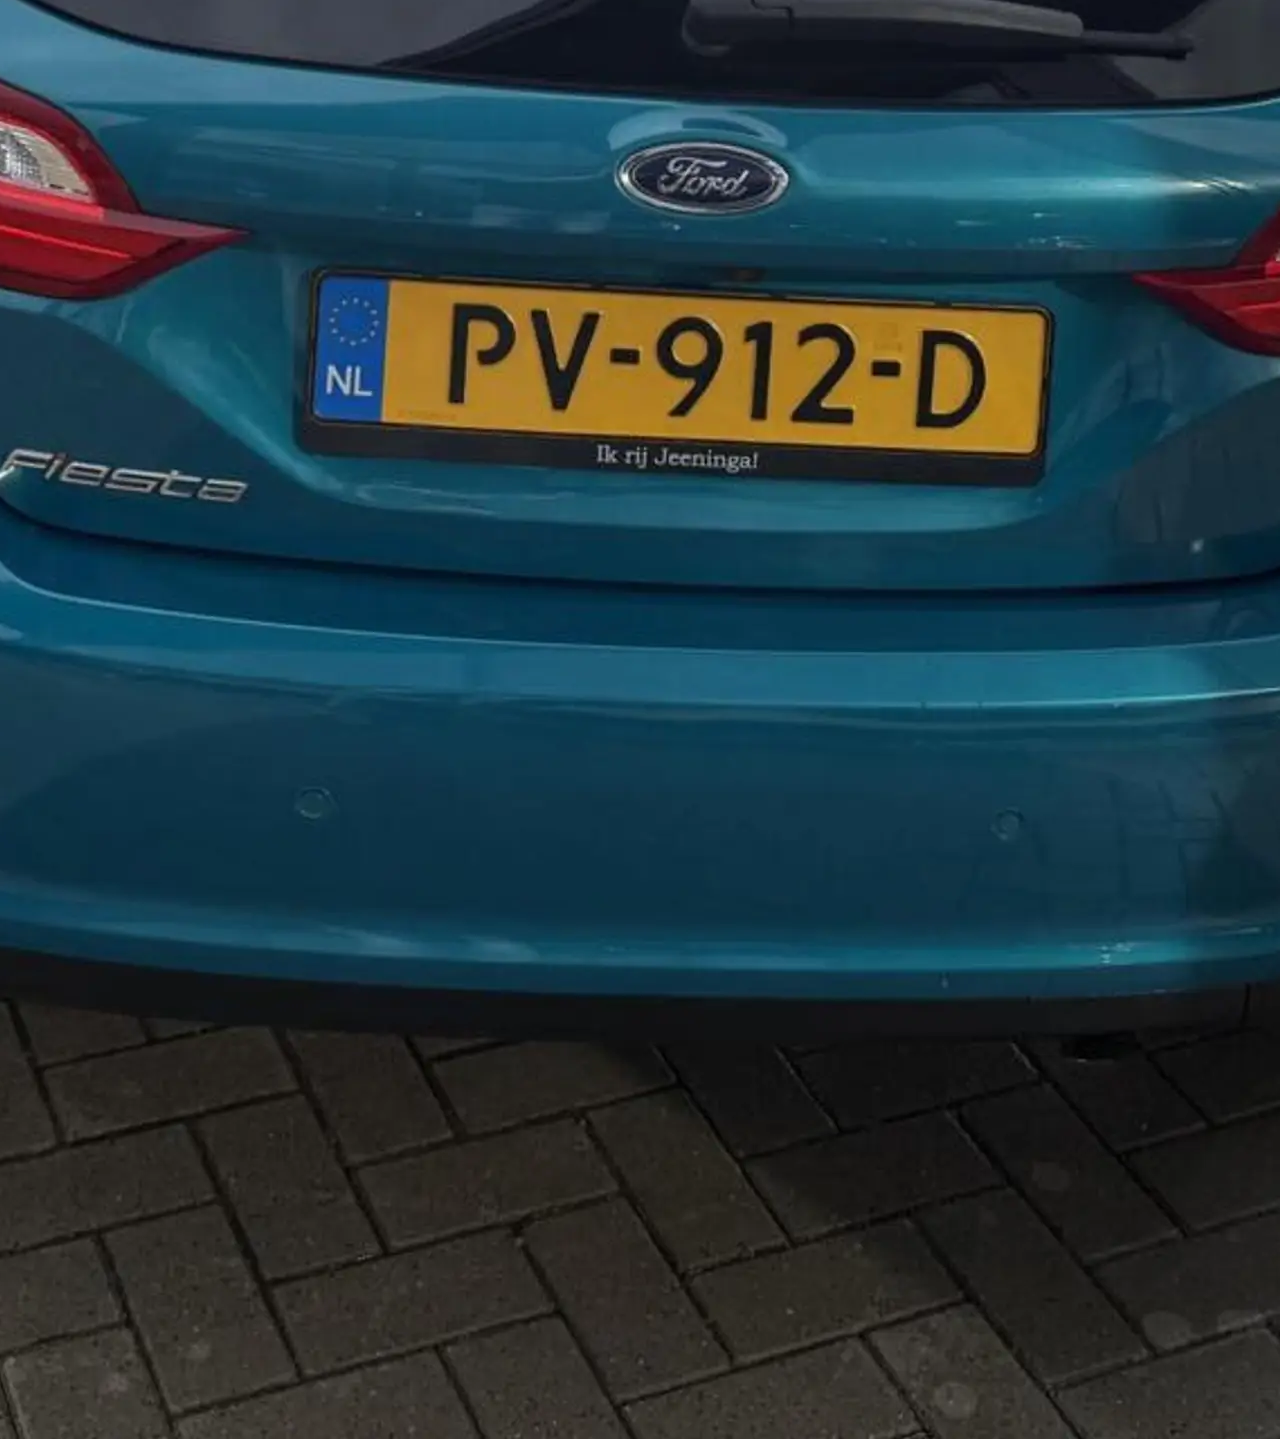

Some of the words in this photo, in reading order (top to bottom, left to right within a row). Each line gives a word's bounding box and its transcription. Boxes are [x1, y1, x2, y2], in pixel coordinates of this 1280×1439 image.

[656, 156, 750, 197] Ford
[325, 364, 373, 398] NL
[446, 301, 987, 430] PV-912-D
[595, 443, 619, 464] Ik
[624, 445, 648, 469] rij
[653, 447, 760, 474] Jeeninga!
